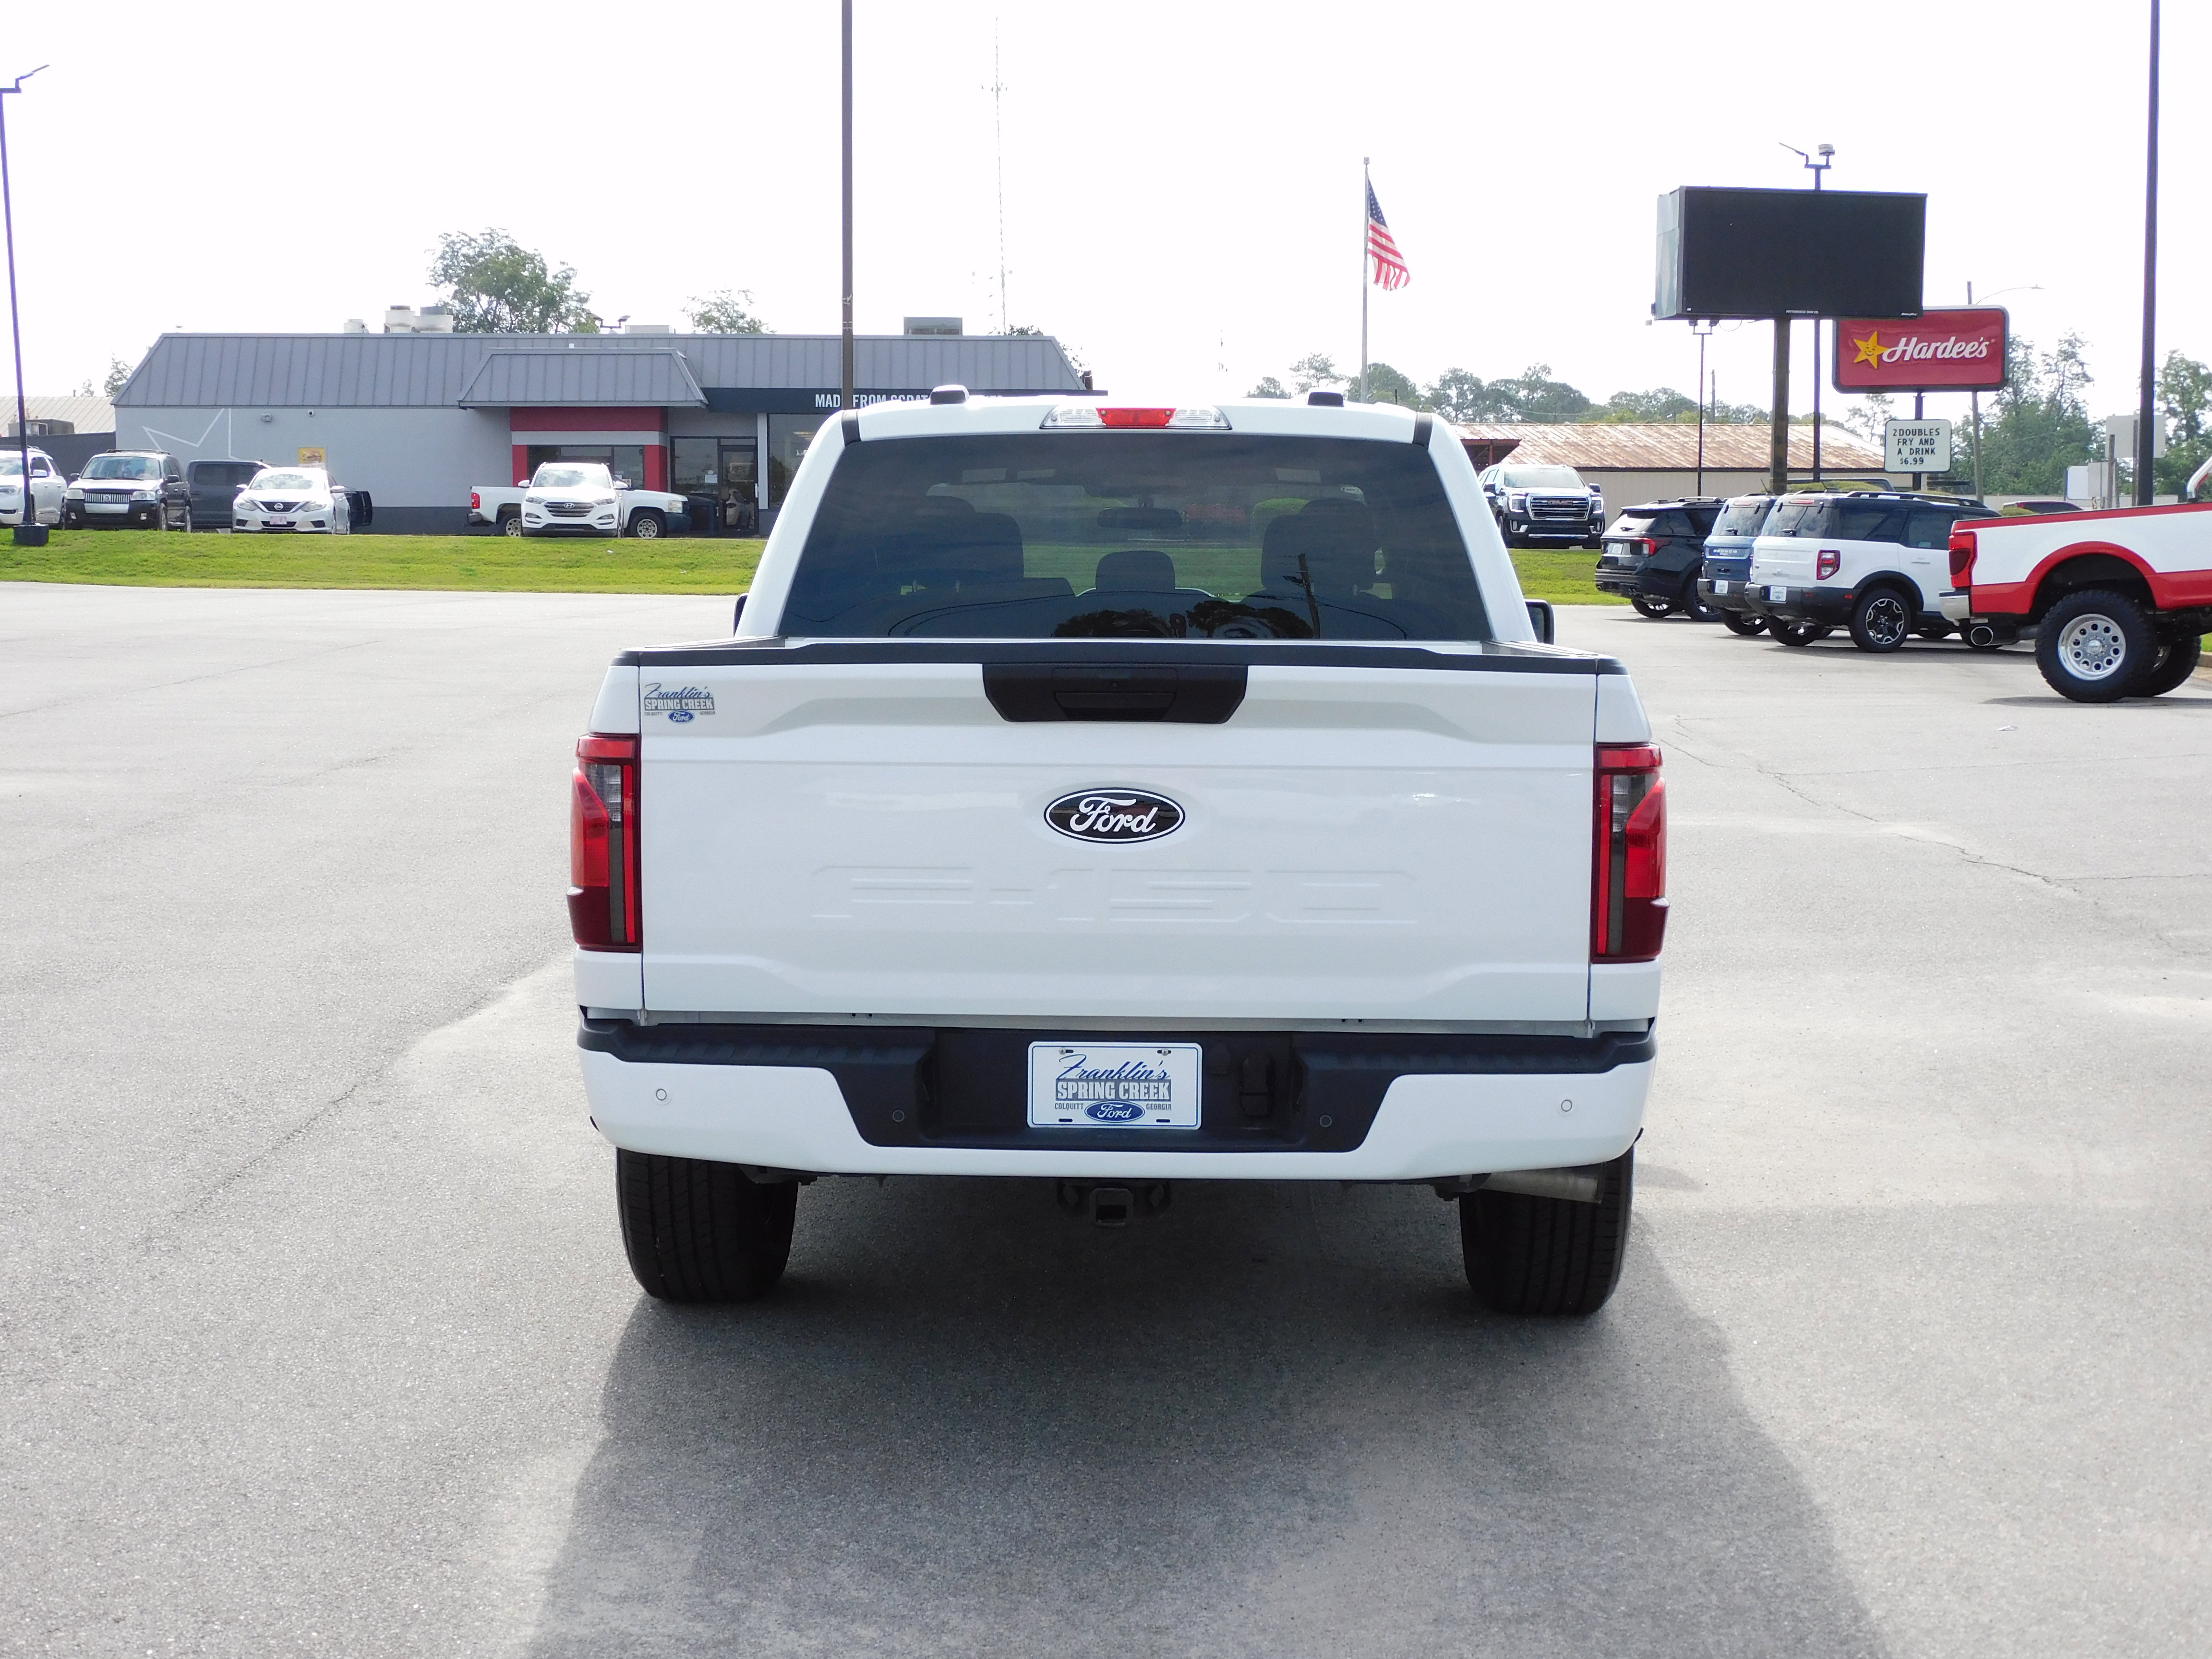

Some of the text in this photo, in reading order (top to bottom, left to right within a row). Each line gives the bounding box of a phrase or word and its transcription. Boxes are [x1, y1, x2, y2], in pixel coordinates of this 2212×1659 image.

[1882, 336, 1990, 362] Hardee's
[815, 394, 841, 408] MAD
[645, 683, 714, 698] Franklin's
[645, 698, 714, 710] SPRING CREEK
[673, 712, 689, 721] Ford
[1070, 797, 1158, 832] Ford
[1057, 1054, 1170, 1080] Franklin's
[1058, 1082, 1170, 1100] SPRING CREEK
[1097, 1105, 1132, 1118] Ford
